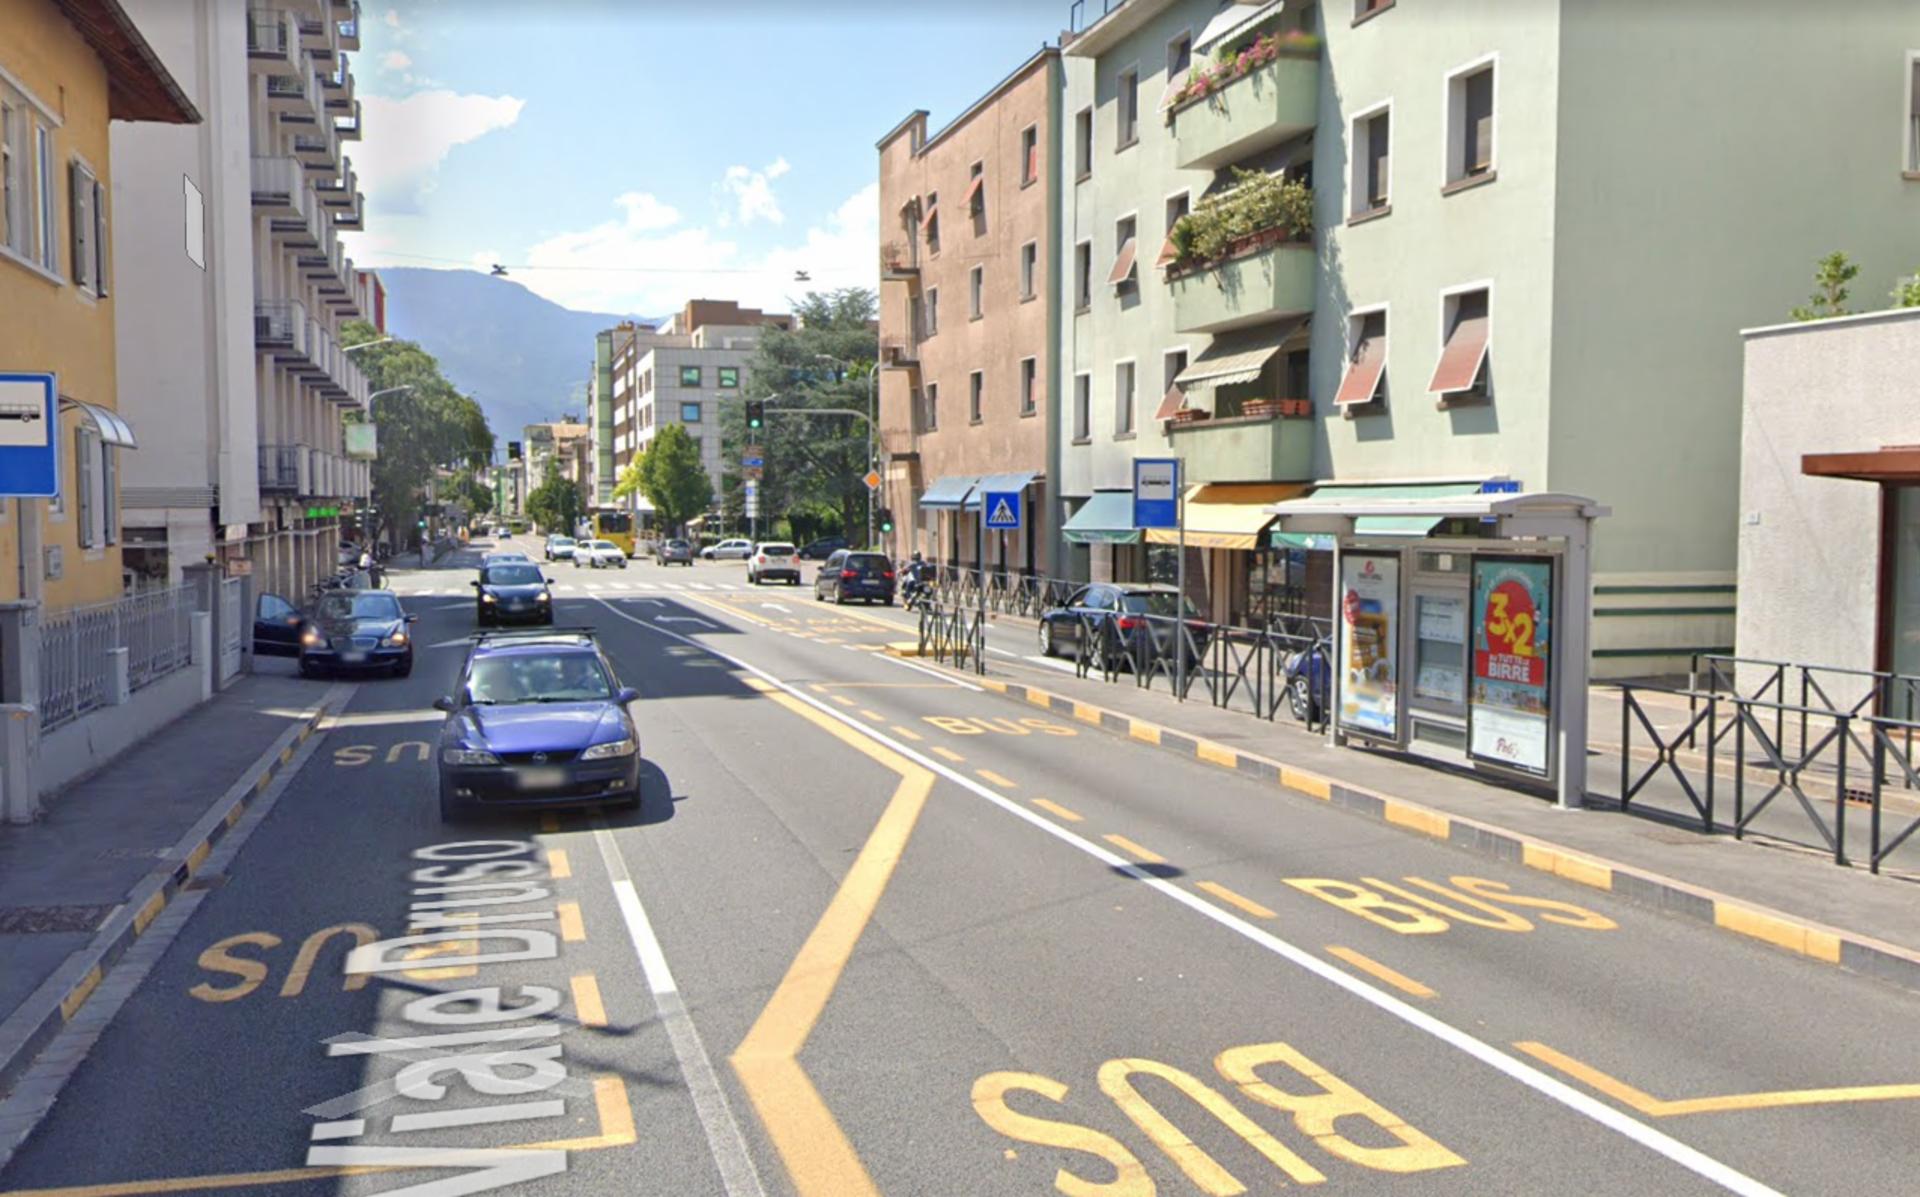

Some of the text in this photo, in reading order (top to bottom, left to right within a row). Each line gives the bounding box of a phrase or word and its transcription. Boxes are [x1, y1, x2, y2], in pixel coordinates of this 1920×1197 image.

[1488, 661, 1531, 682] BIRRE
[922, 715, 1079, 737] BUS
[334, 741, 430, 766] US
[1280, 875, 1620, 935] BUS
[971, 1041, 1469, 1197] BUS
